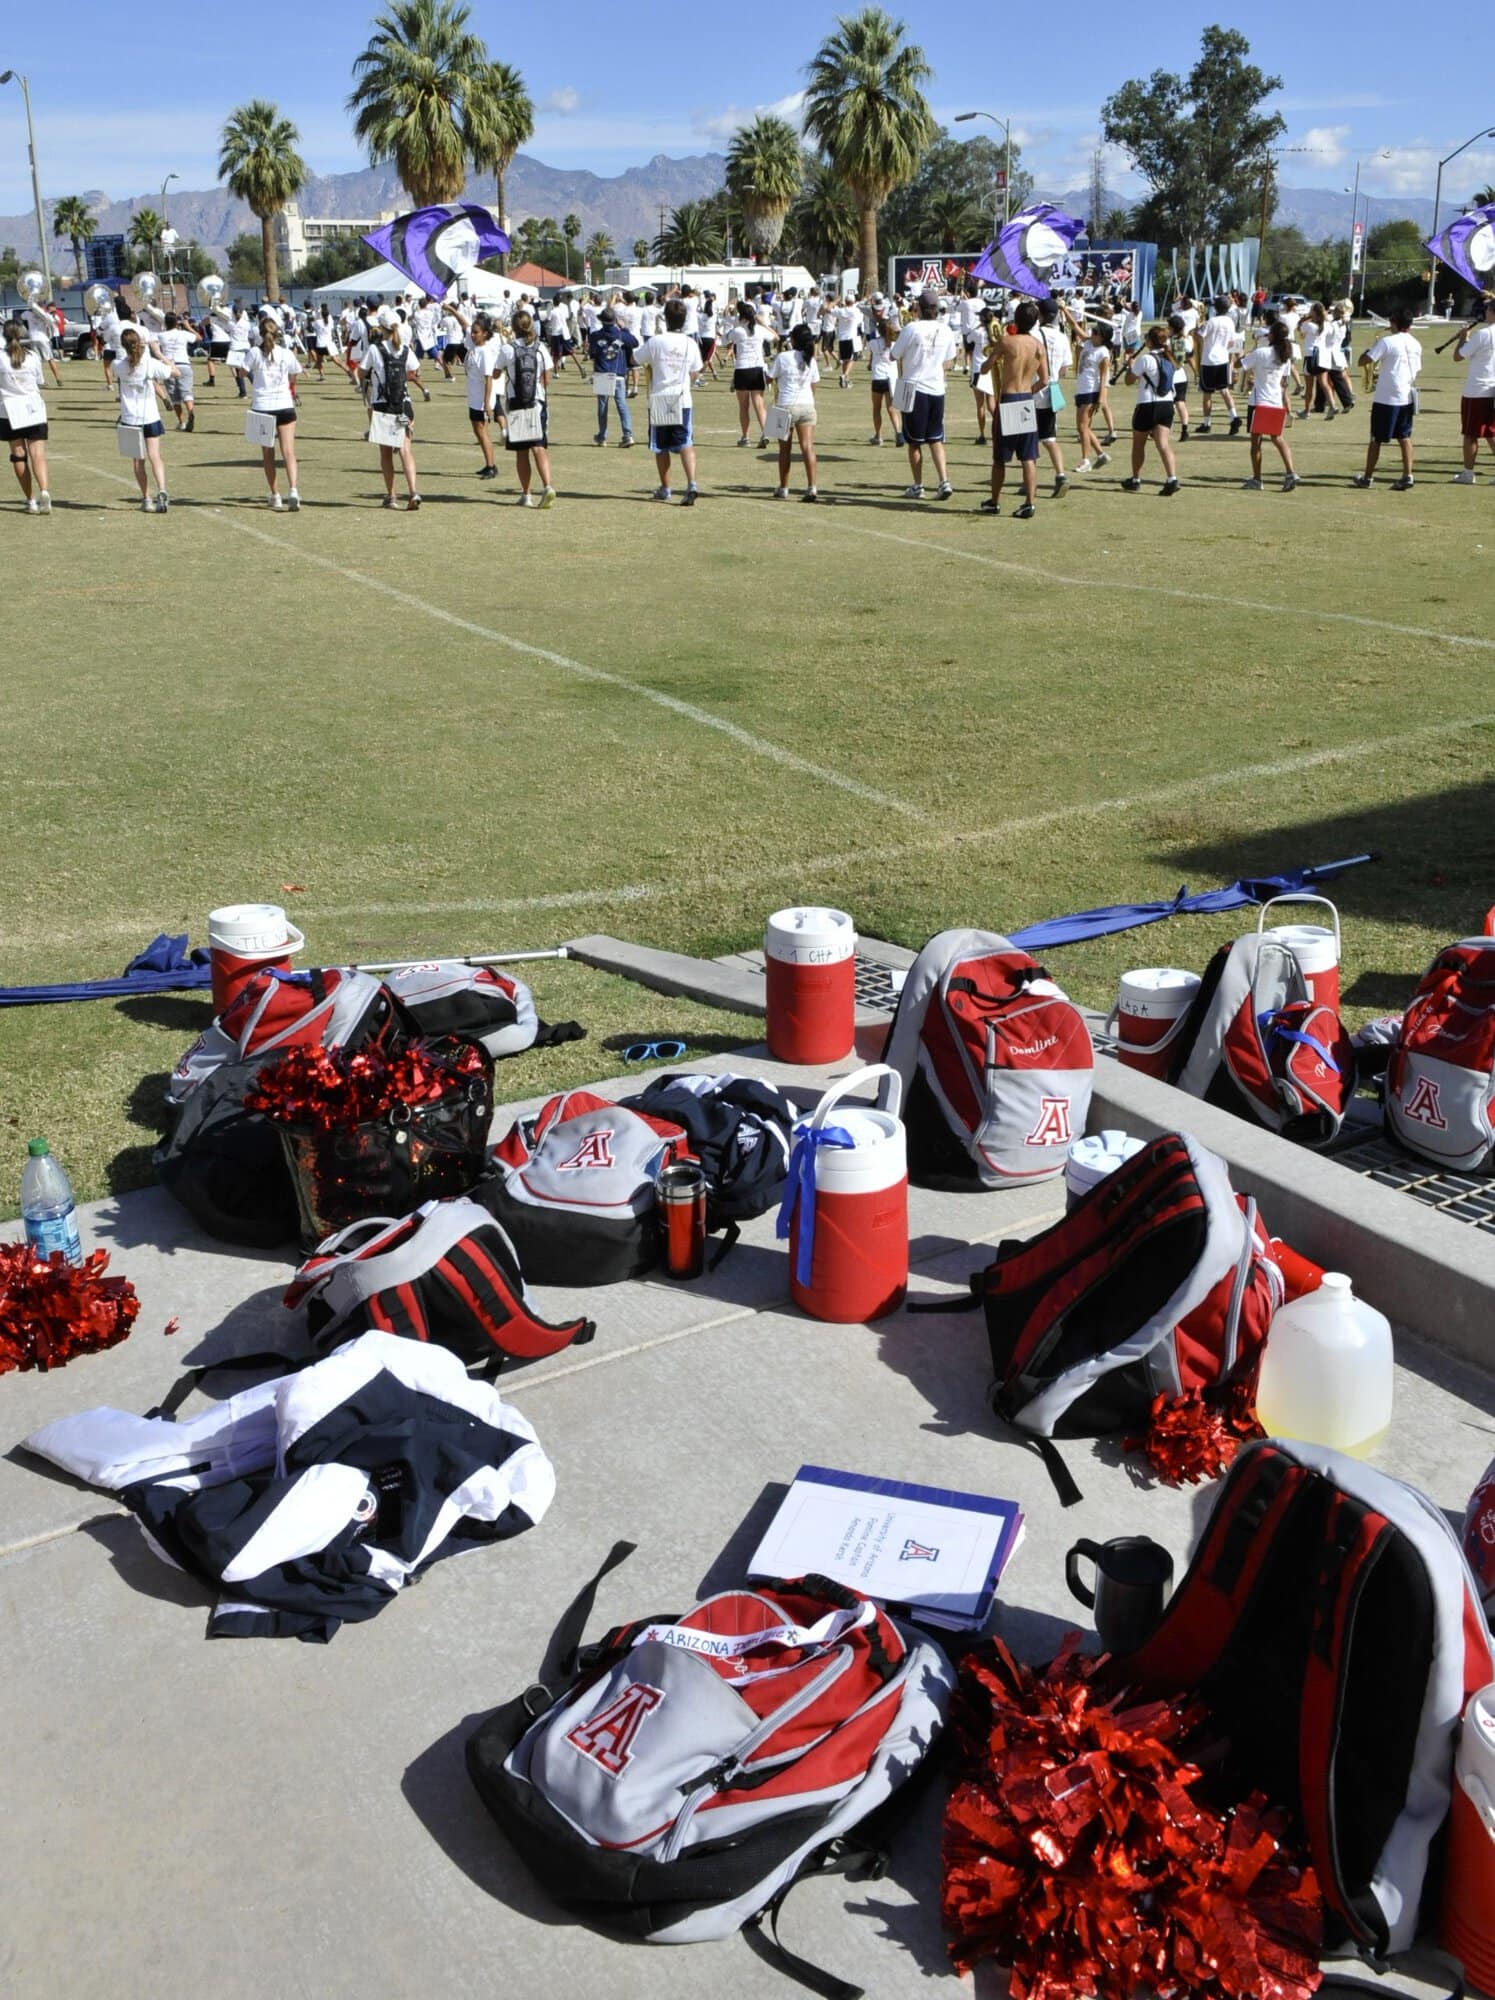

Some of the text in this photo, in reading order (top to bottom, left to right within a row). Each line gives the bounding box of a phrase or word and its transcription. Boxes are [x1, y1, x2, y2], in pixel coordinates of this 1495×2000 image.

[1024, 1096, 1073, 1147] A
[1403, 1074, 1448, 1131] A
[556, 1130, 616, 1172] A
[899, 1539, 939, 1562] A
[664, 1629, 729, 1655] ARIZONA
[562, 1682, 666, 1781] A
